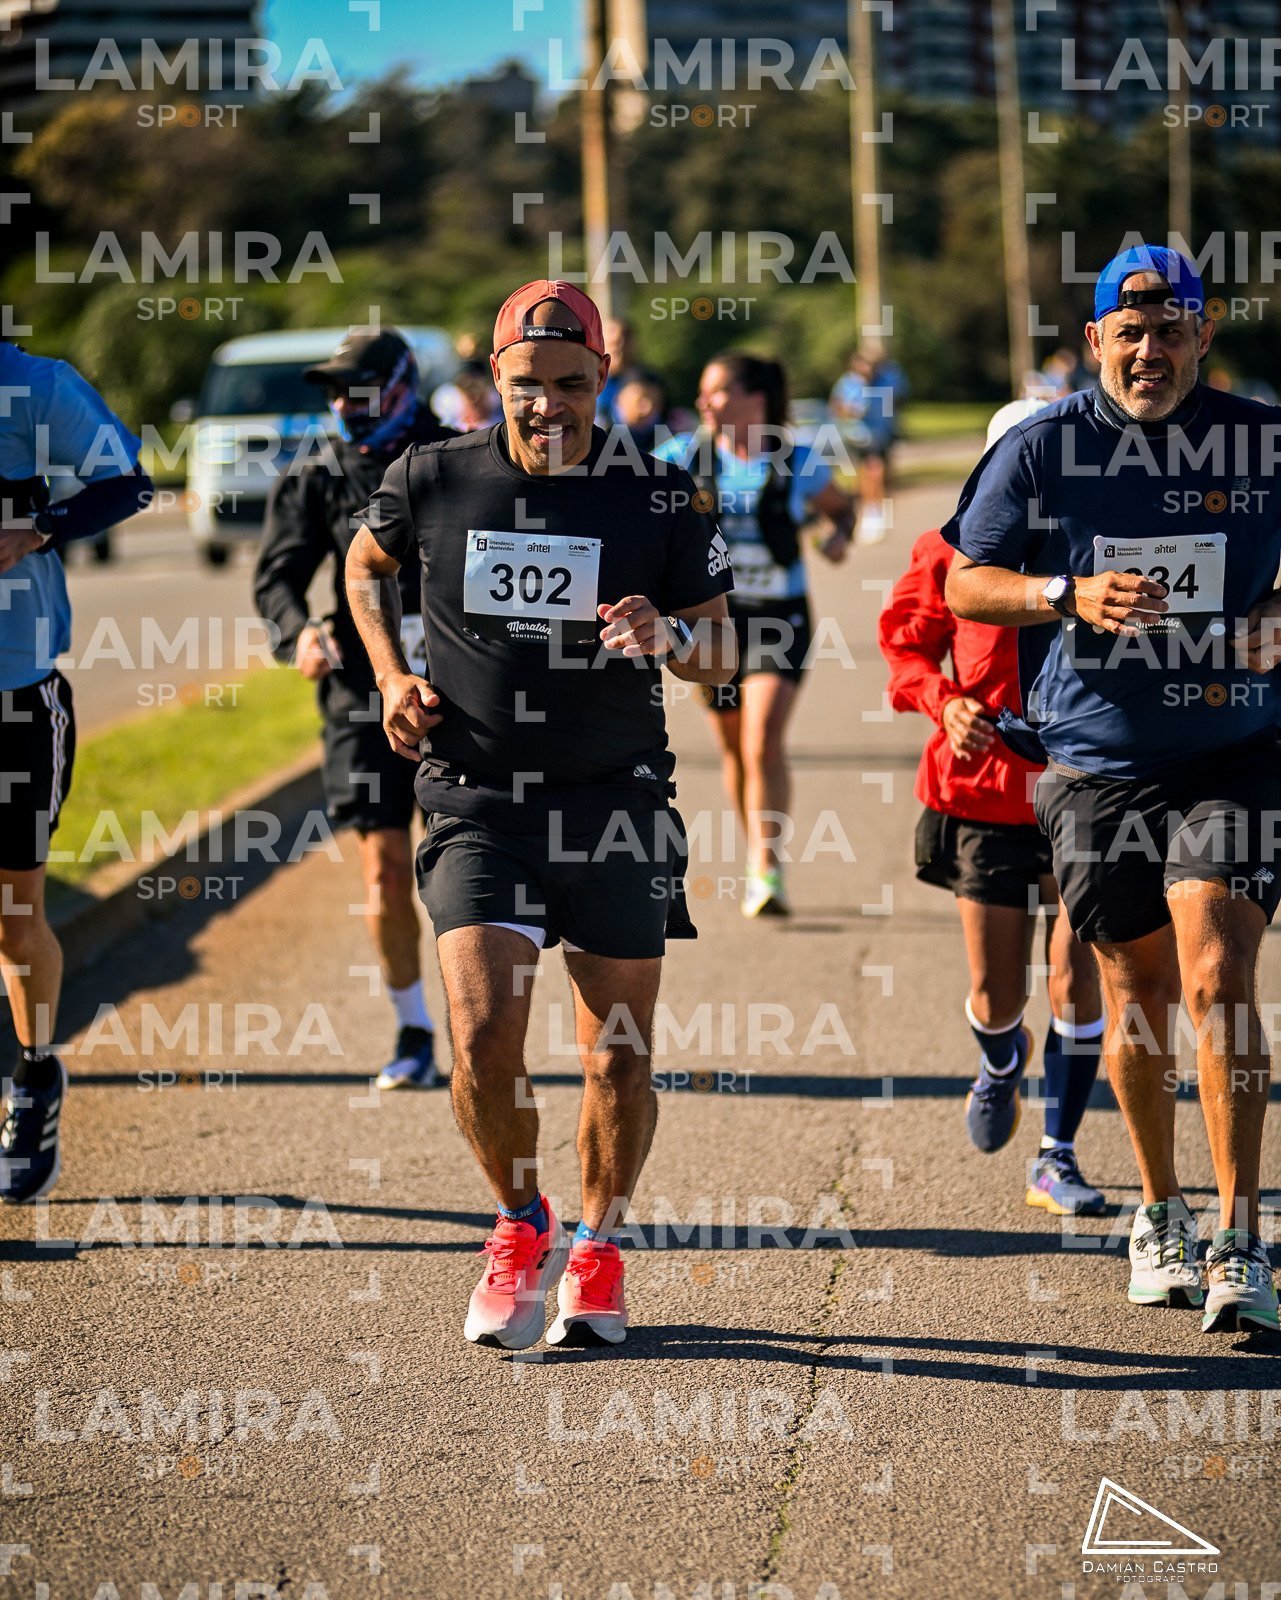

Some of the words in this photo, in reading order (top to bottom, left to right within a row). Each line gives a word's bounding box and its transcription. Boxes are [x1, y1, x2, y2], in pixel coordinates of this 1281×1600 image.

[533, 329, 563, 338] Columbia
[527, 542, 551, 553] antel
[1154, 544, 1177, 554] antel
[489, 563, 572, 606] 302
[1122, 563, 1199, 600] 34
[506, 620, 553, 635] Maratón
